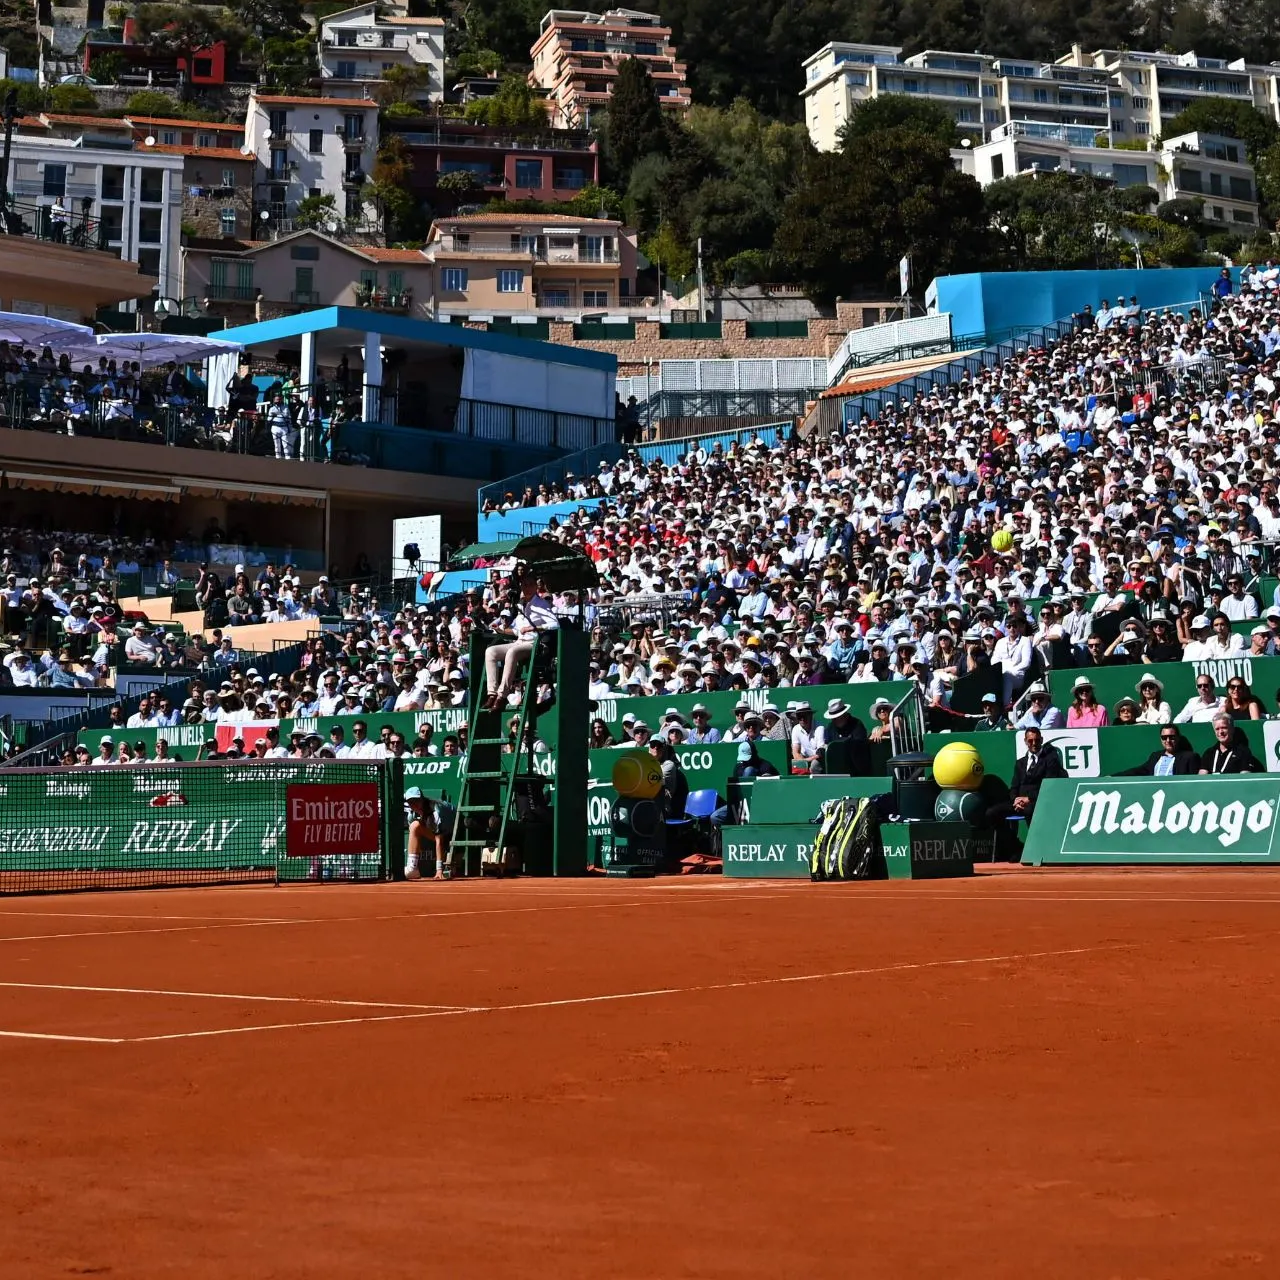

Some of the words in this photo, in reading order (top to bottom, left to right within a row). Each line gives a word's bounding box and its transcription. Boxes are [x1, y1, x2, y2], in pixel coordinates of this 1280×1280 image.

[1192, 659, 1253, 688] TORONTO
[741, 690, 770, 713] ROME
[415, 709, 469, 733] MONTE-CARL
[180, 726, 204, 746] WELLS
[403, 761, 451, 774] NLOP
[292, 796, 374, 821] Emirates
[1071, 789, 1273, 847] Malongo
[121, 819, 242, 853] REPLAY
[304, 824, 322, 844] FLY
[325, 823, 361, 843] BETTER
[592, 828, 611, 836] WATER
[728, 844, 787, 862] REPLAY
[883, 846, 908, 857] PLAY
[914, 838, 970, 861] REPLAY
